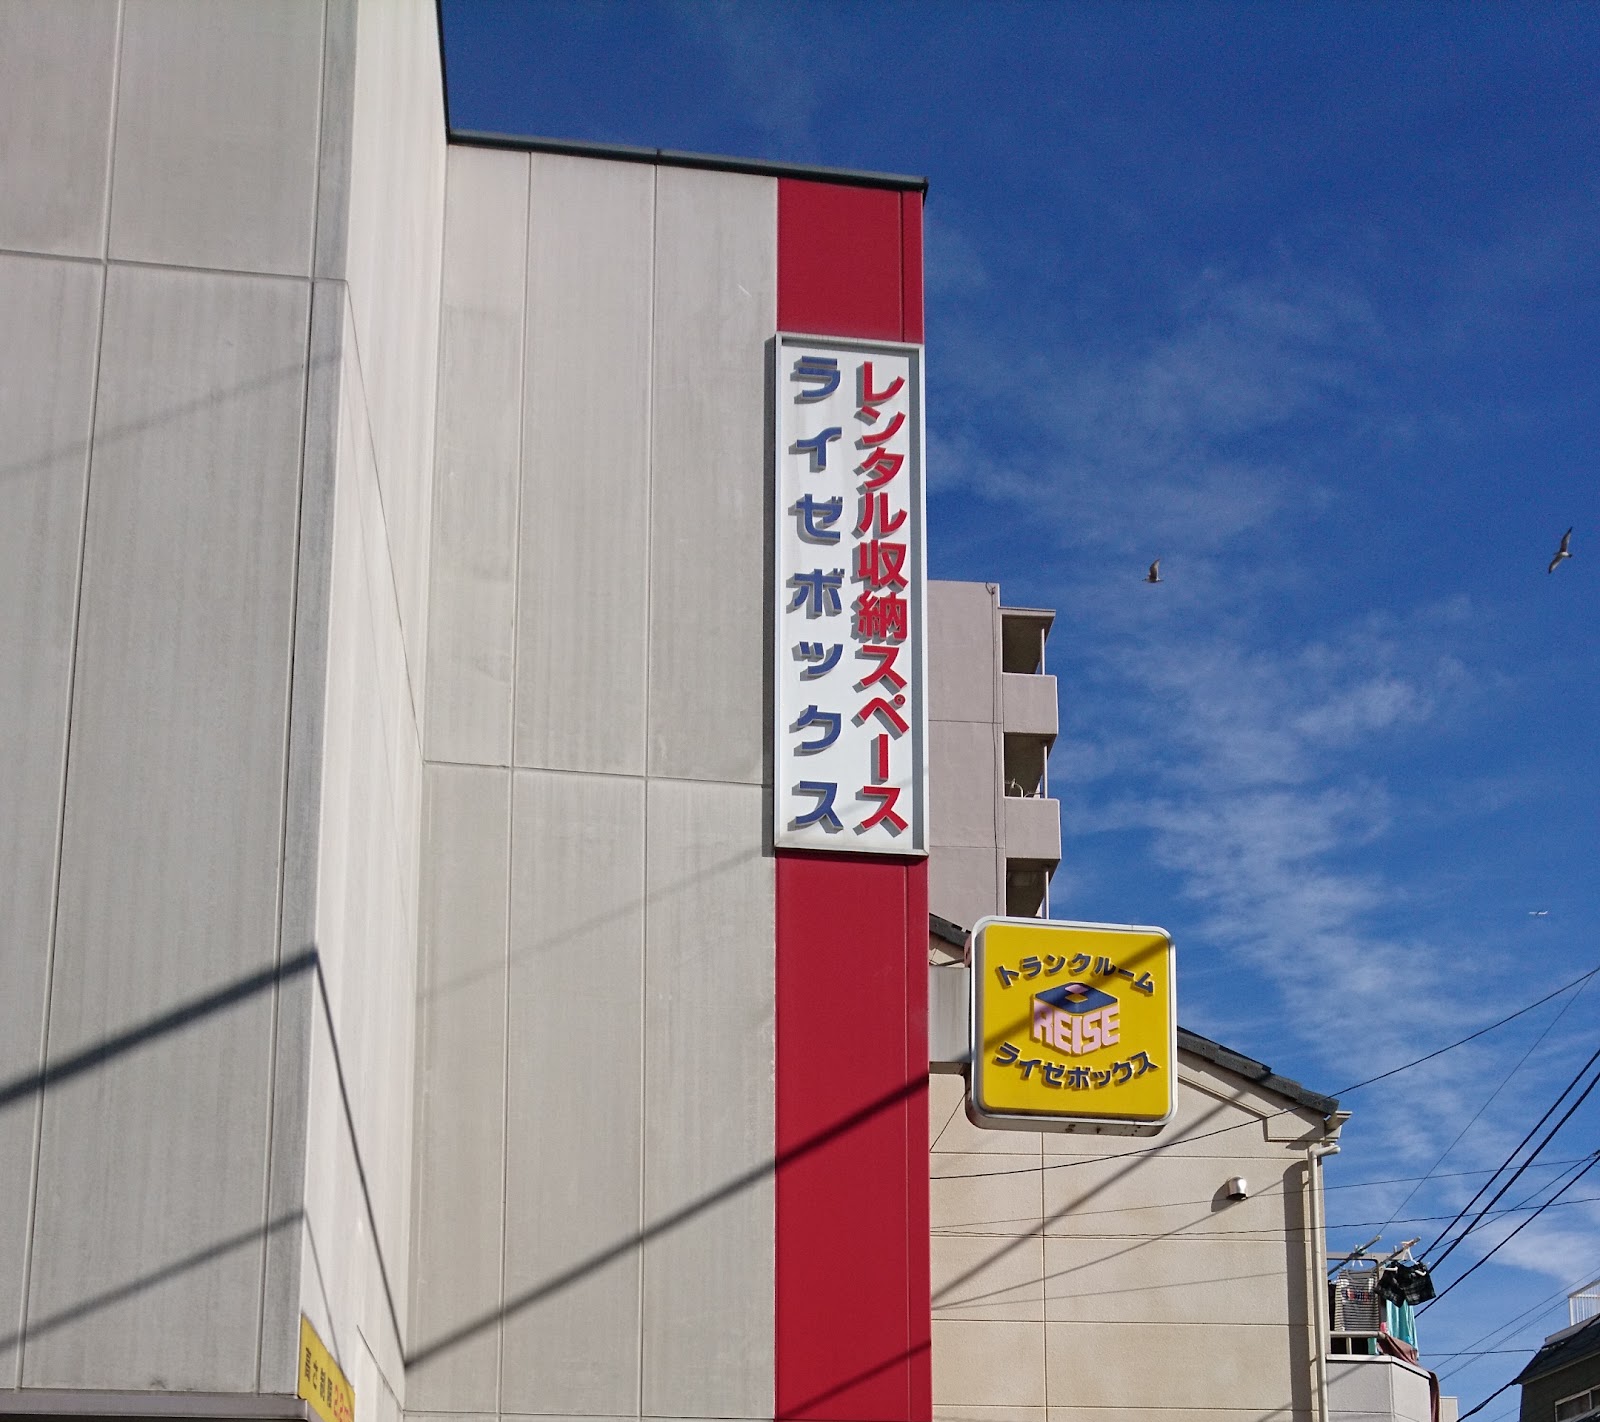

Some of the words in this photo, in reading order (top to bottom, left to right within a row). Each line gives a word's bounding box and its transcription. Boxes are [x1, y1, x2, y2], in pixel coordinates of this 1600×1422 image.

[792, 355, 845, 834] ライゼボックス
[857, 360, 909, 834] レンタル収納スペース
[997, 953, 1154, 996] トランクルーム
[1033, 999, 1120, 1055] REISE
[996, 1042, 1159, 1089] ライゼボックス
